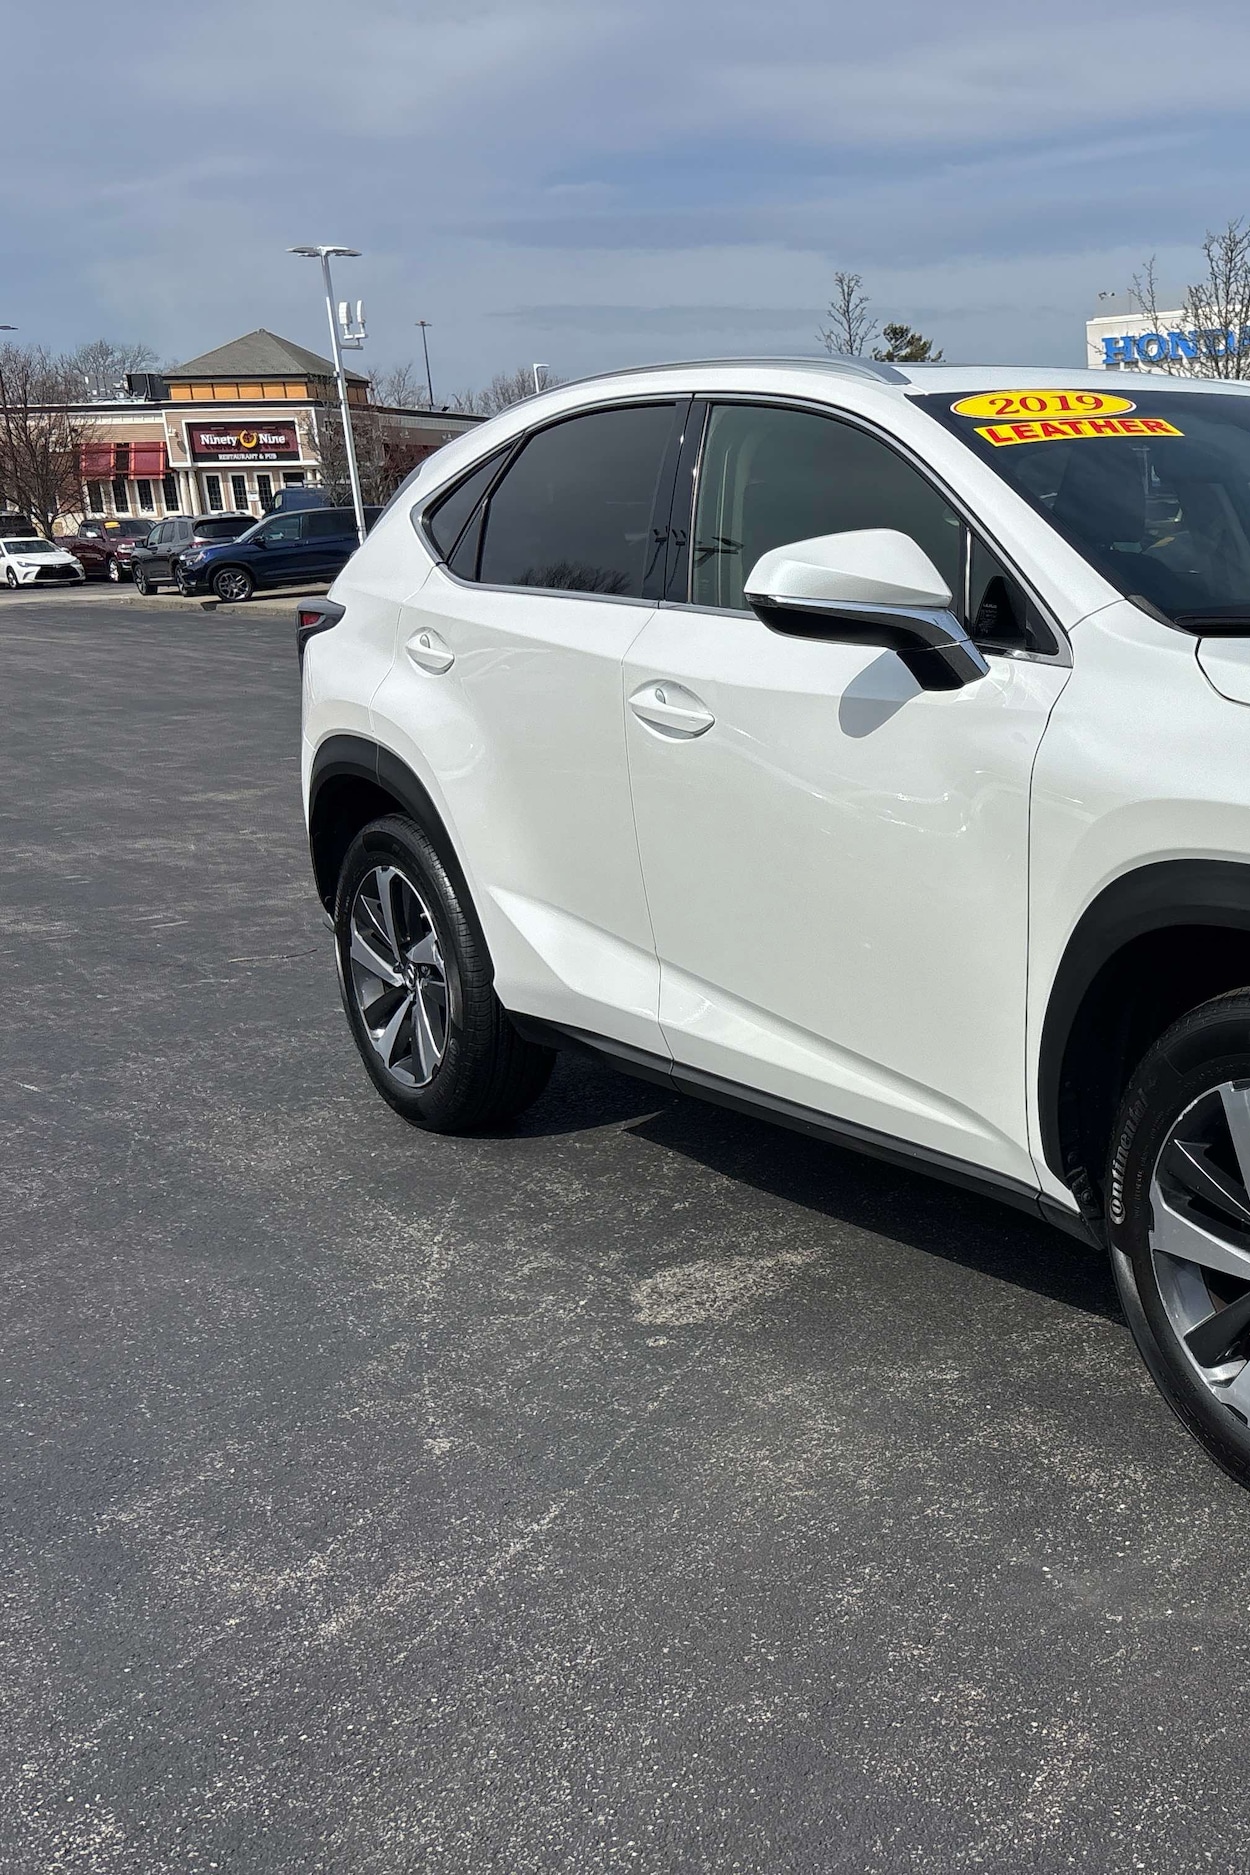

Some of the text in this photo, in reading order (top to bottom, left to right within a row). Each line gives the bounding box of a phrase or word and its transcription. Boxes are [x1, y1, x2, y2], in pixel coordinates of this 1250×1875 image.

[988, 395, 1105, 416] 2019
[200, 433, 239, 446] Ninety
[259, 433, 286, 444] Nine
[985, 419, 1175, 443] LEATHER
[1109, 1087, 1149, 1225] Continental
